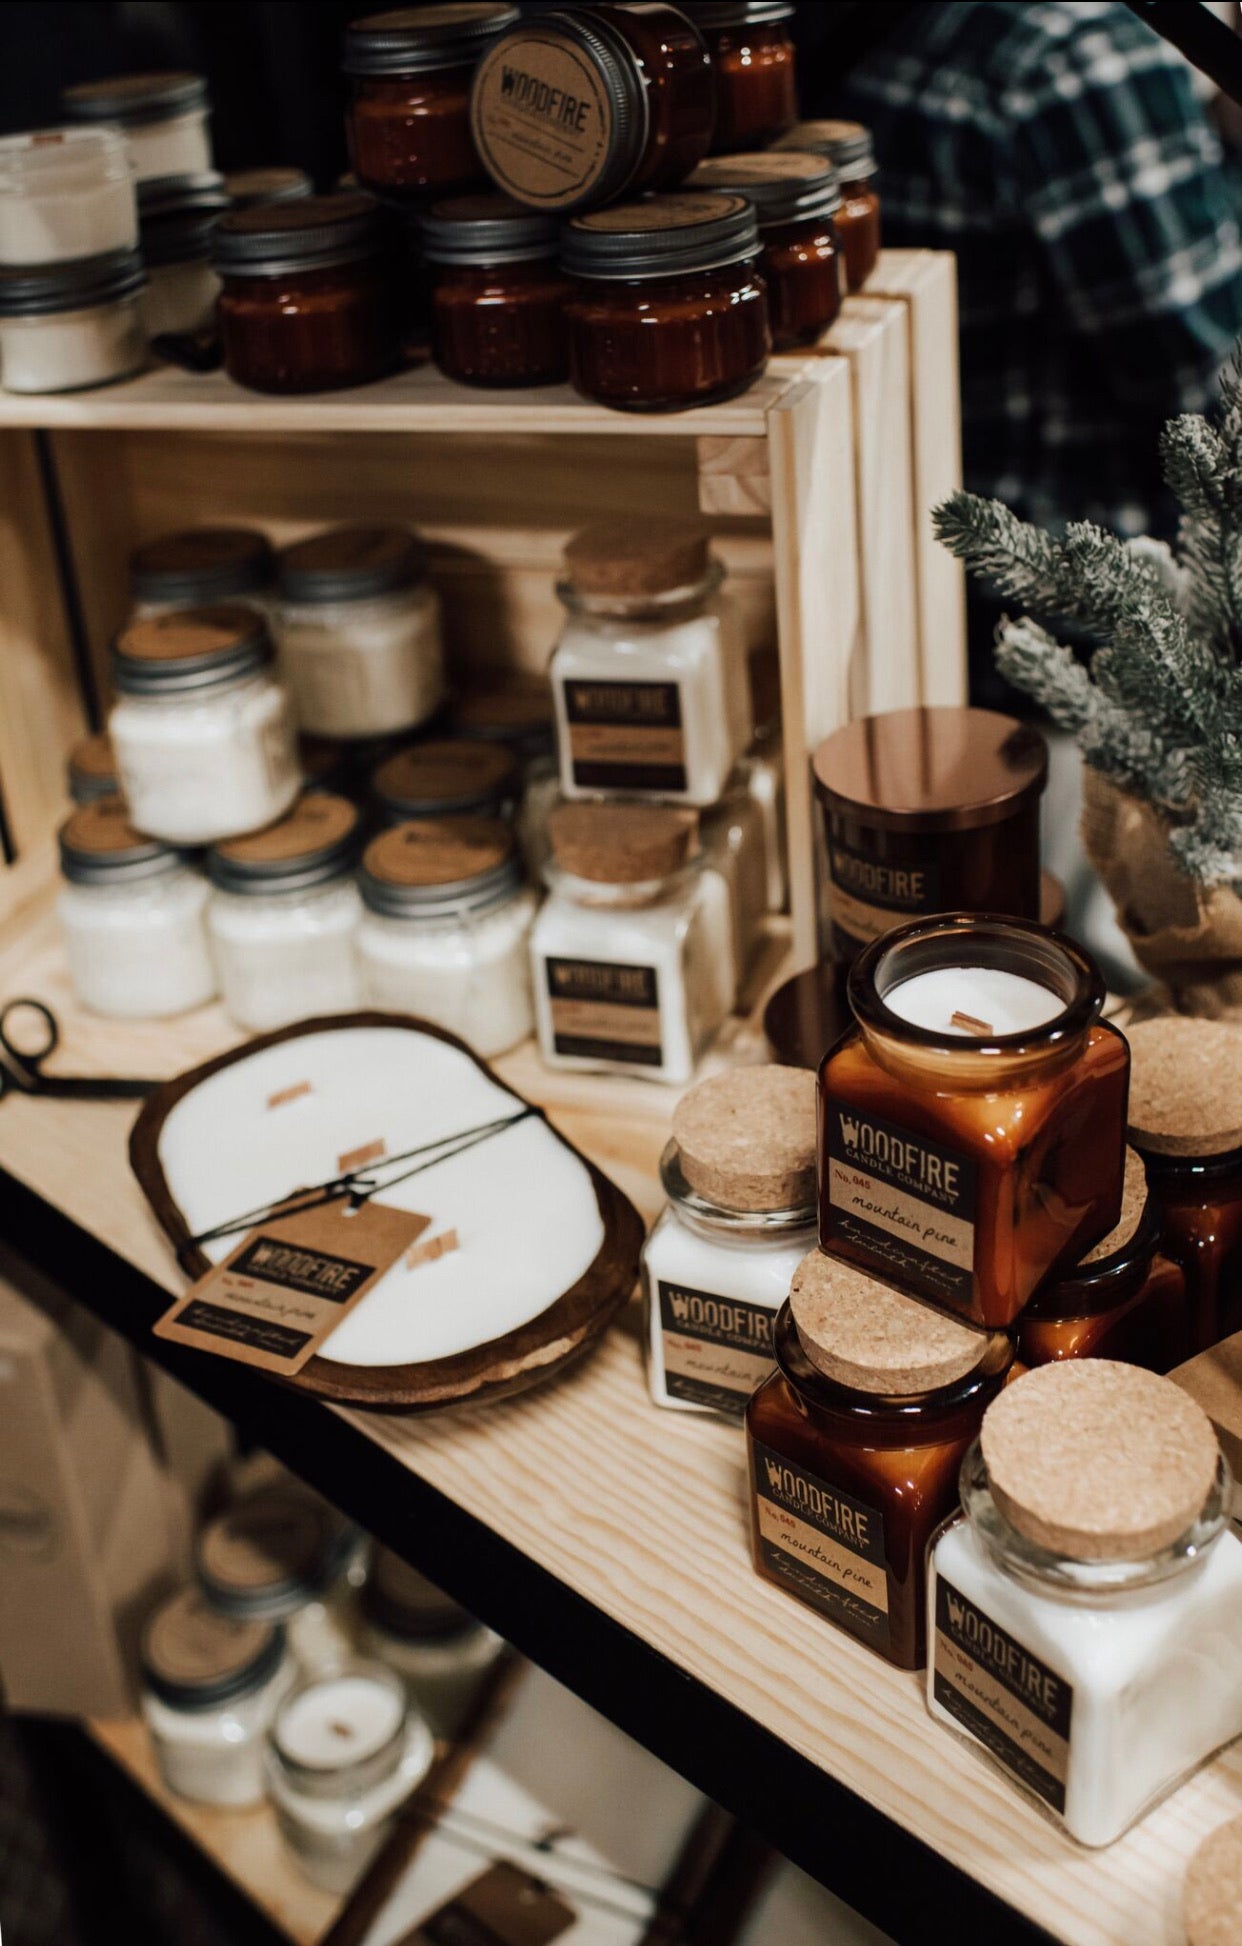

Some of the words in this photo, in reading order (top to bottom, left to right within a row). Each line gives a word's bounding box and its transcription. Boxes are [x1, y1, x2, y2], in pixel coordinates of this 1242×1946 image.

[502, 66, 591, 134] WOODFIRE
[840, 1113, 959, 1197] WOODFIRE
[846, 1149, 896, 1177] CANDLE
[897, 1173, 956, 1205] COMPANY
[852, 1196, 920, 1232] mountain
[922, 1226, 958, 1248] pine
[251, 1243, 361, 1289] WOODFIRE
[765, 1456, 870, 1545] WOODFIRE
[780, 1533, 841, 1572] mountain
[842, 1562, 873, 1588] pine
[946, 1591, 1060, 1706] WOODFIRE
[955, 1670, 1020, 1732] mountain
